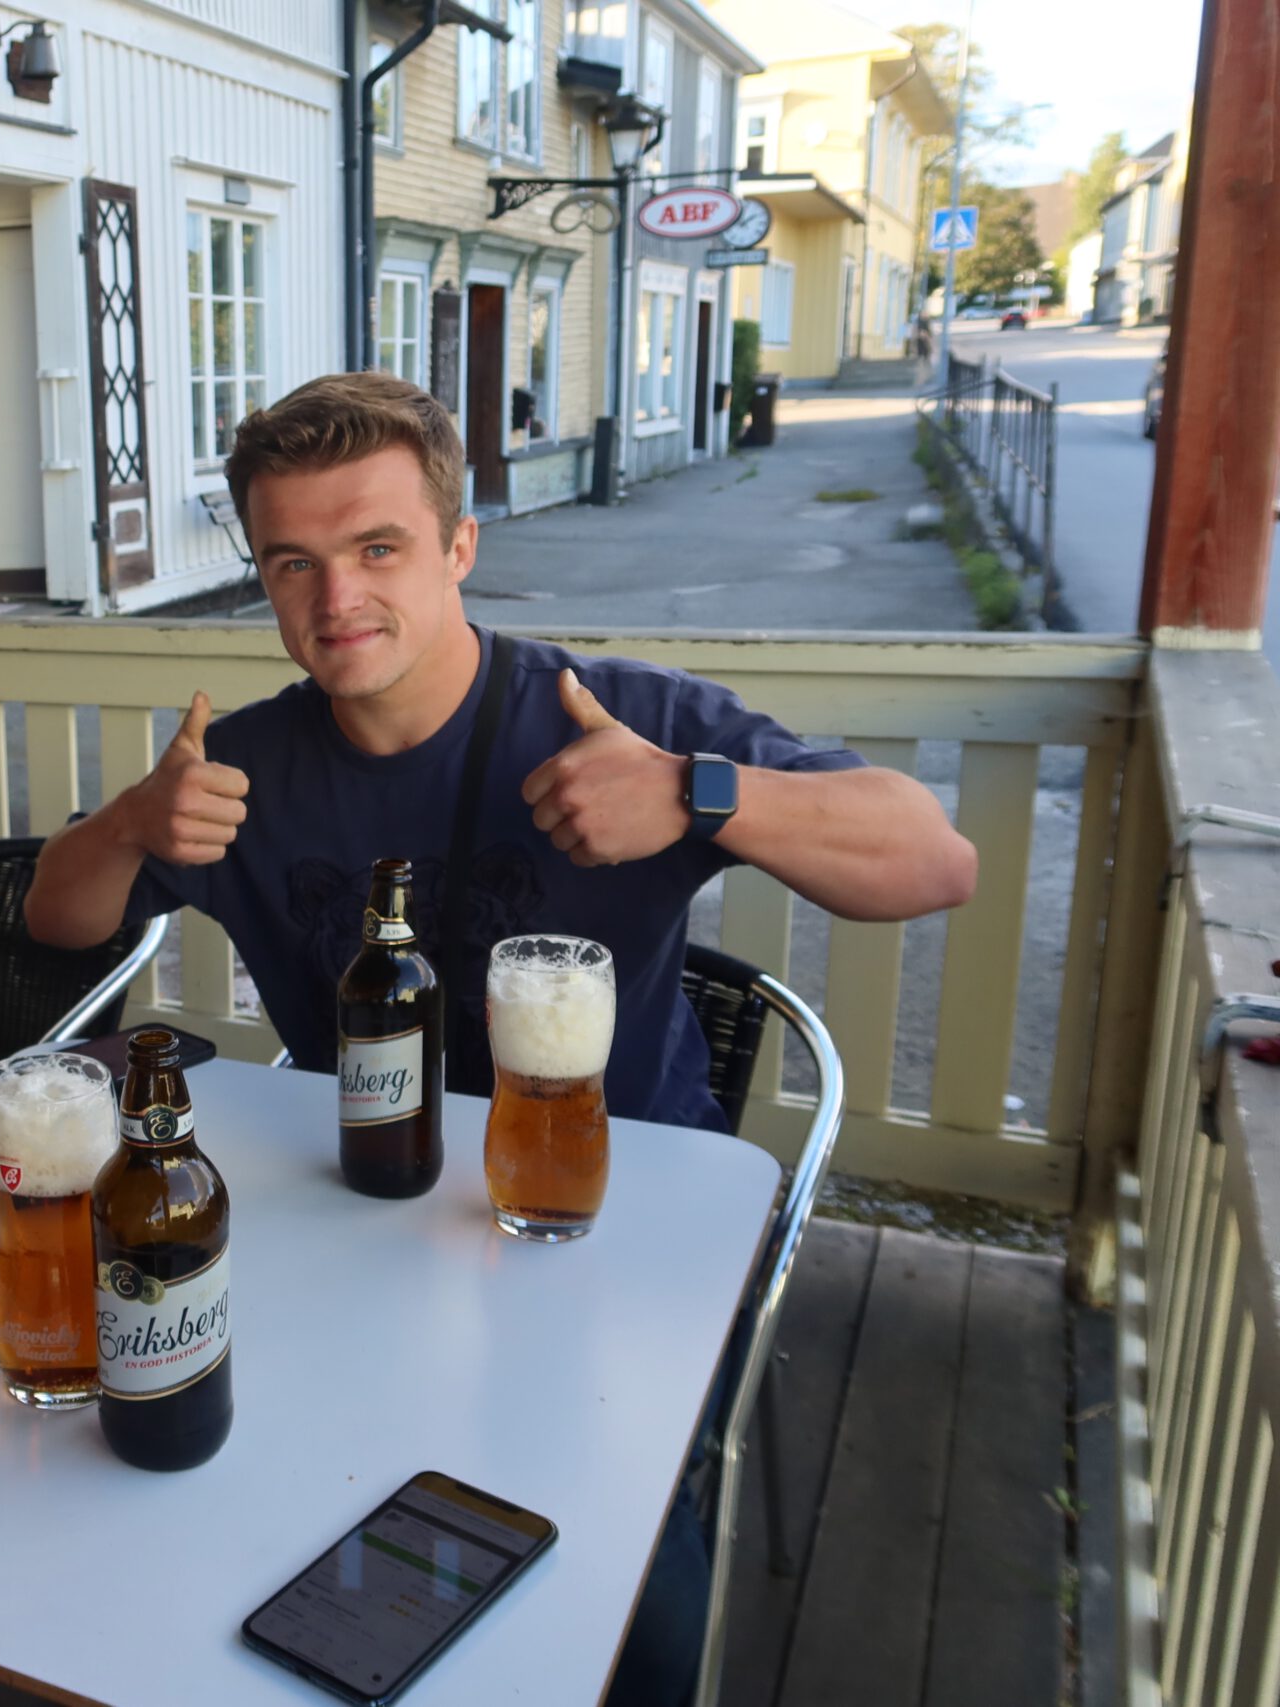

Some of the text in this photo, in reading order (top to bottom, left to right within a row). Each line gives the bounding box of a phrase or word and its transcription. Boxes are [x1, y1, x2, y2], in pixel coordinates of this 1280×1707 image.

[659, 201, 719, 224] ABF
[339, 1062, 414, 1104] ksberg
[97, 1287, 228, 1361] Eriksberg
[124, 1336, 213, 1369] EN GOD HISTORIA
